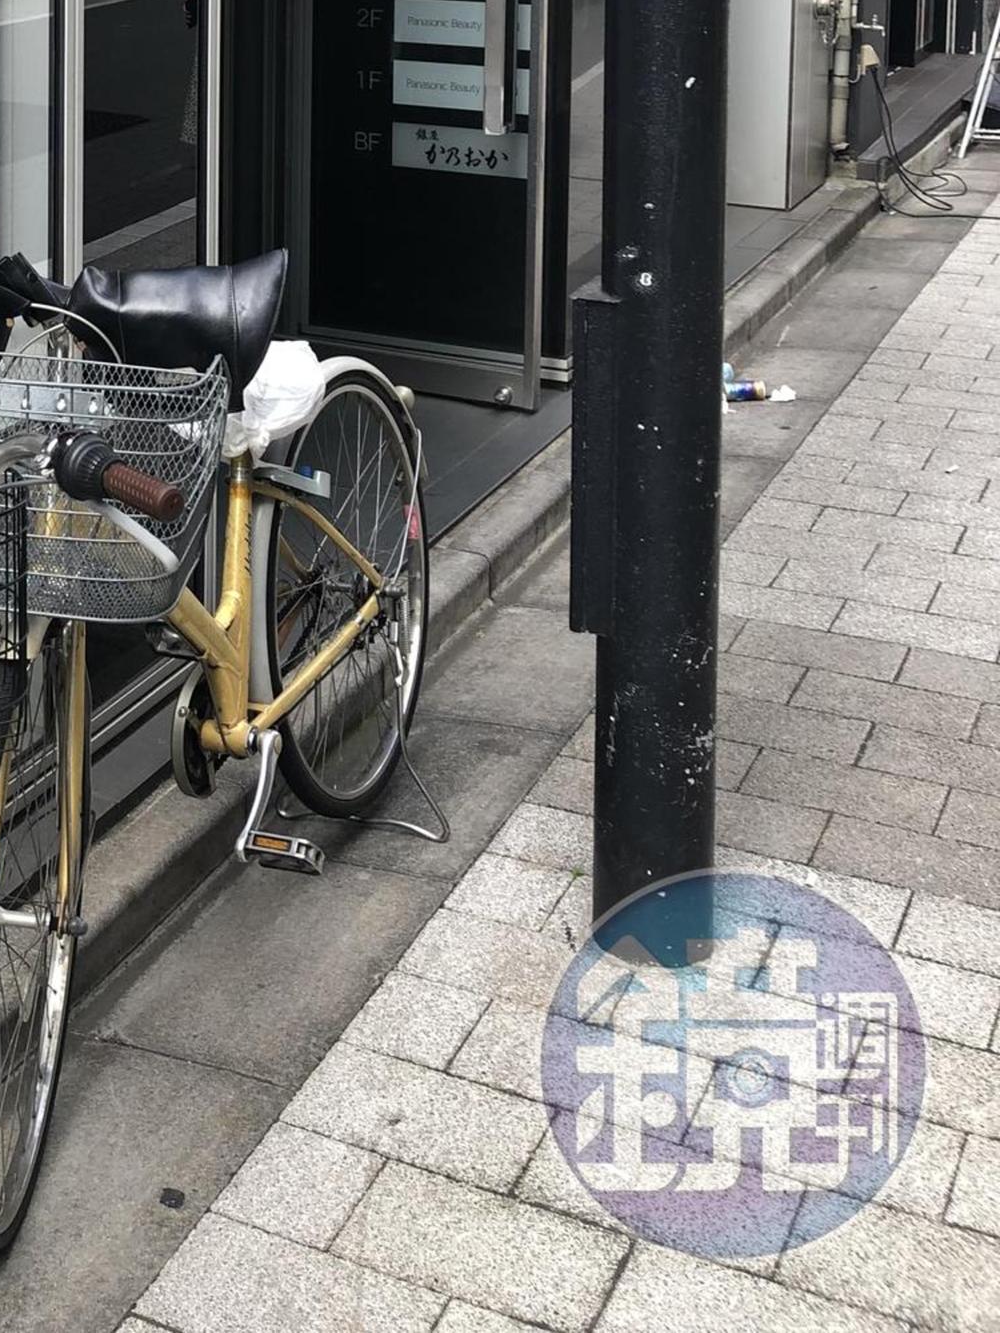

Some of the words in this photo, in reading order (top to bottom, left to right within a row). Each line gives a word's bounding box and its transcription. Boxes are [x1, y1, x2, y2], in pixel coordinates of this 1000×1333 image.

[356, 8, 384, 28] 2F
[407, 16, 449, 27] Panasonic
[451, 18, 482, 31] Beauty
[356, 70, 383, 90] 1F
[406, 78, 449, 90] Panasonic
[449, 82, 481, 94] Beauty
[354, 131, 382, 152] BF
